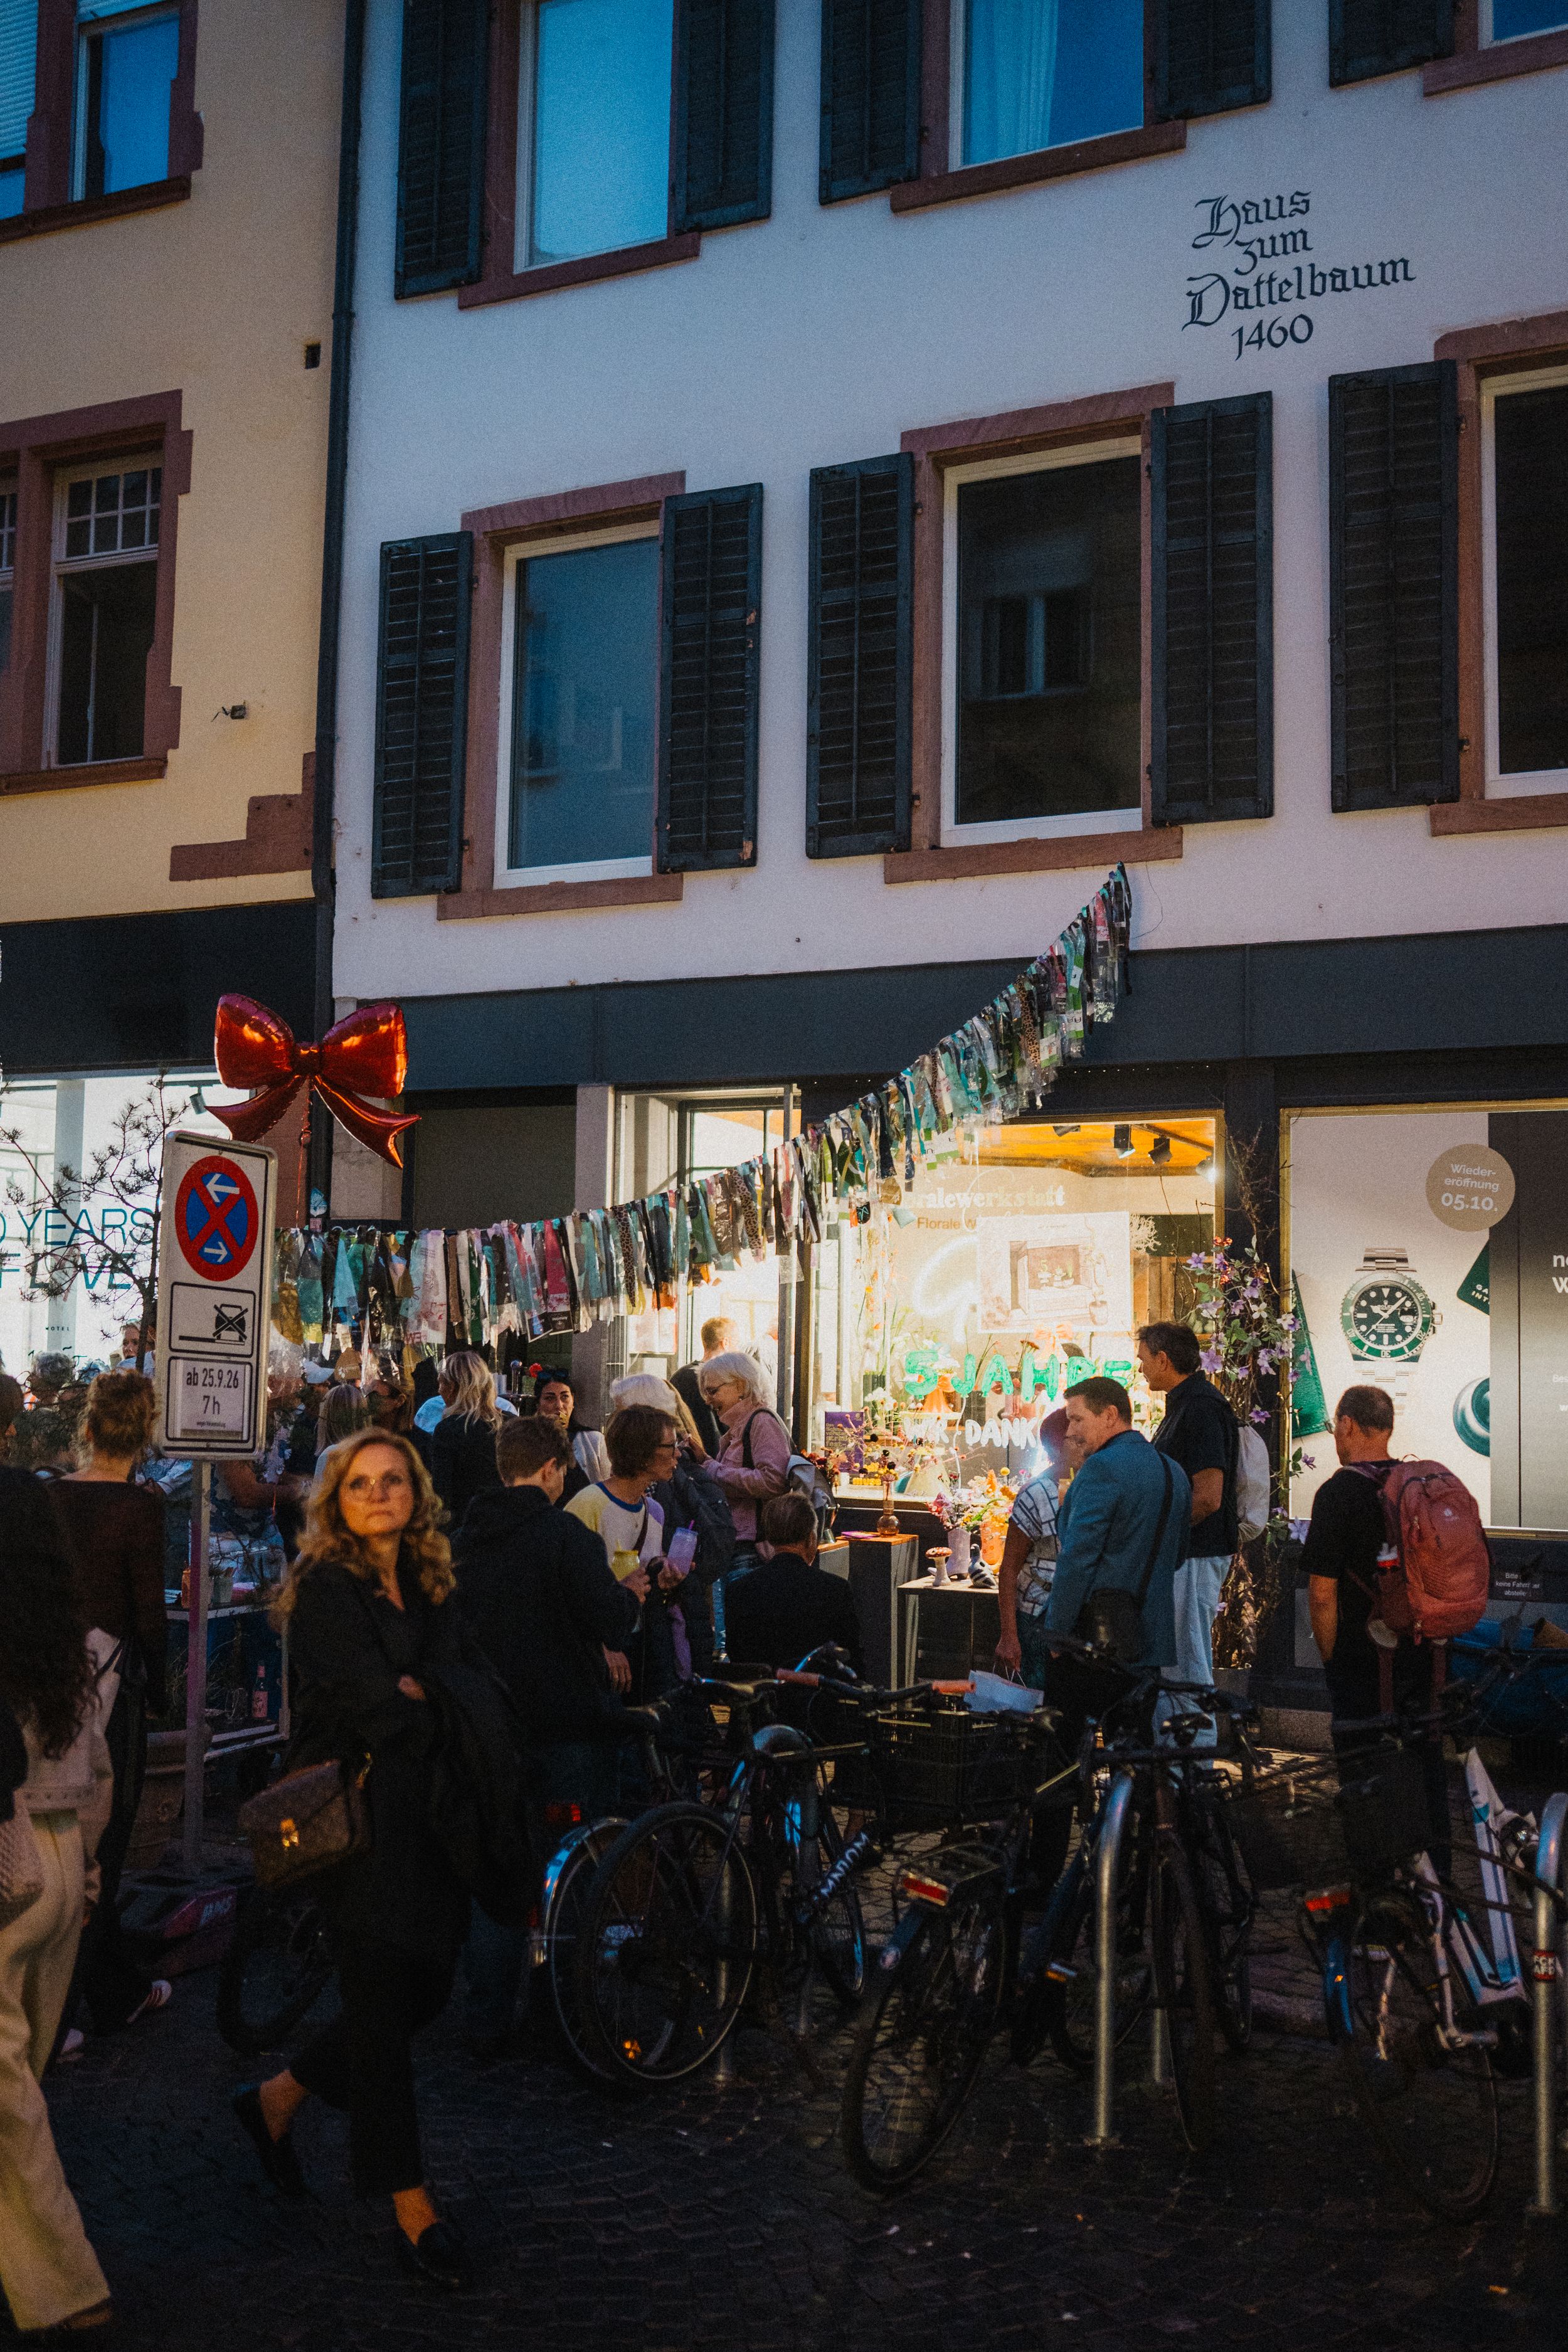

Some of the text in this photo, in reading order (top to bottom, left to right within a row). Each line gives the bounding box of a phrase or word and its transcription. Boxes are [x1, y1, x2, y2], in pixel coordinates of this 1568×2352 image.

[1192, 190, 1311, 248] Haus
[1234, 228, 1313, 275] zum
[1182, 257, 1416, 331] Dattelbaum
[1231, 314, 1313, 361] 1460
[1451, 1163, 1496, 1177] Wieder-
[1444, 1177, 1499, 1192] eröffnung
[1441, 1192, 1498, 1212] 05.10.
[18, 1207, 155, 1246] YEARS
[917, 1217, 960, 1230] Florale
[1471, 1291, 1490, 1305] INT
[186, 1367, 239, 1389] ab 25.9.26
[904, 1350, 939, 1400] 5
[203, 1395, 220, 1415] 7 h
[965, 1416, 1041, 1449] DANK
